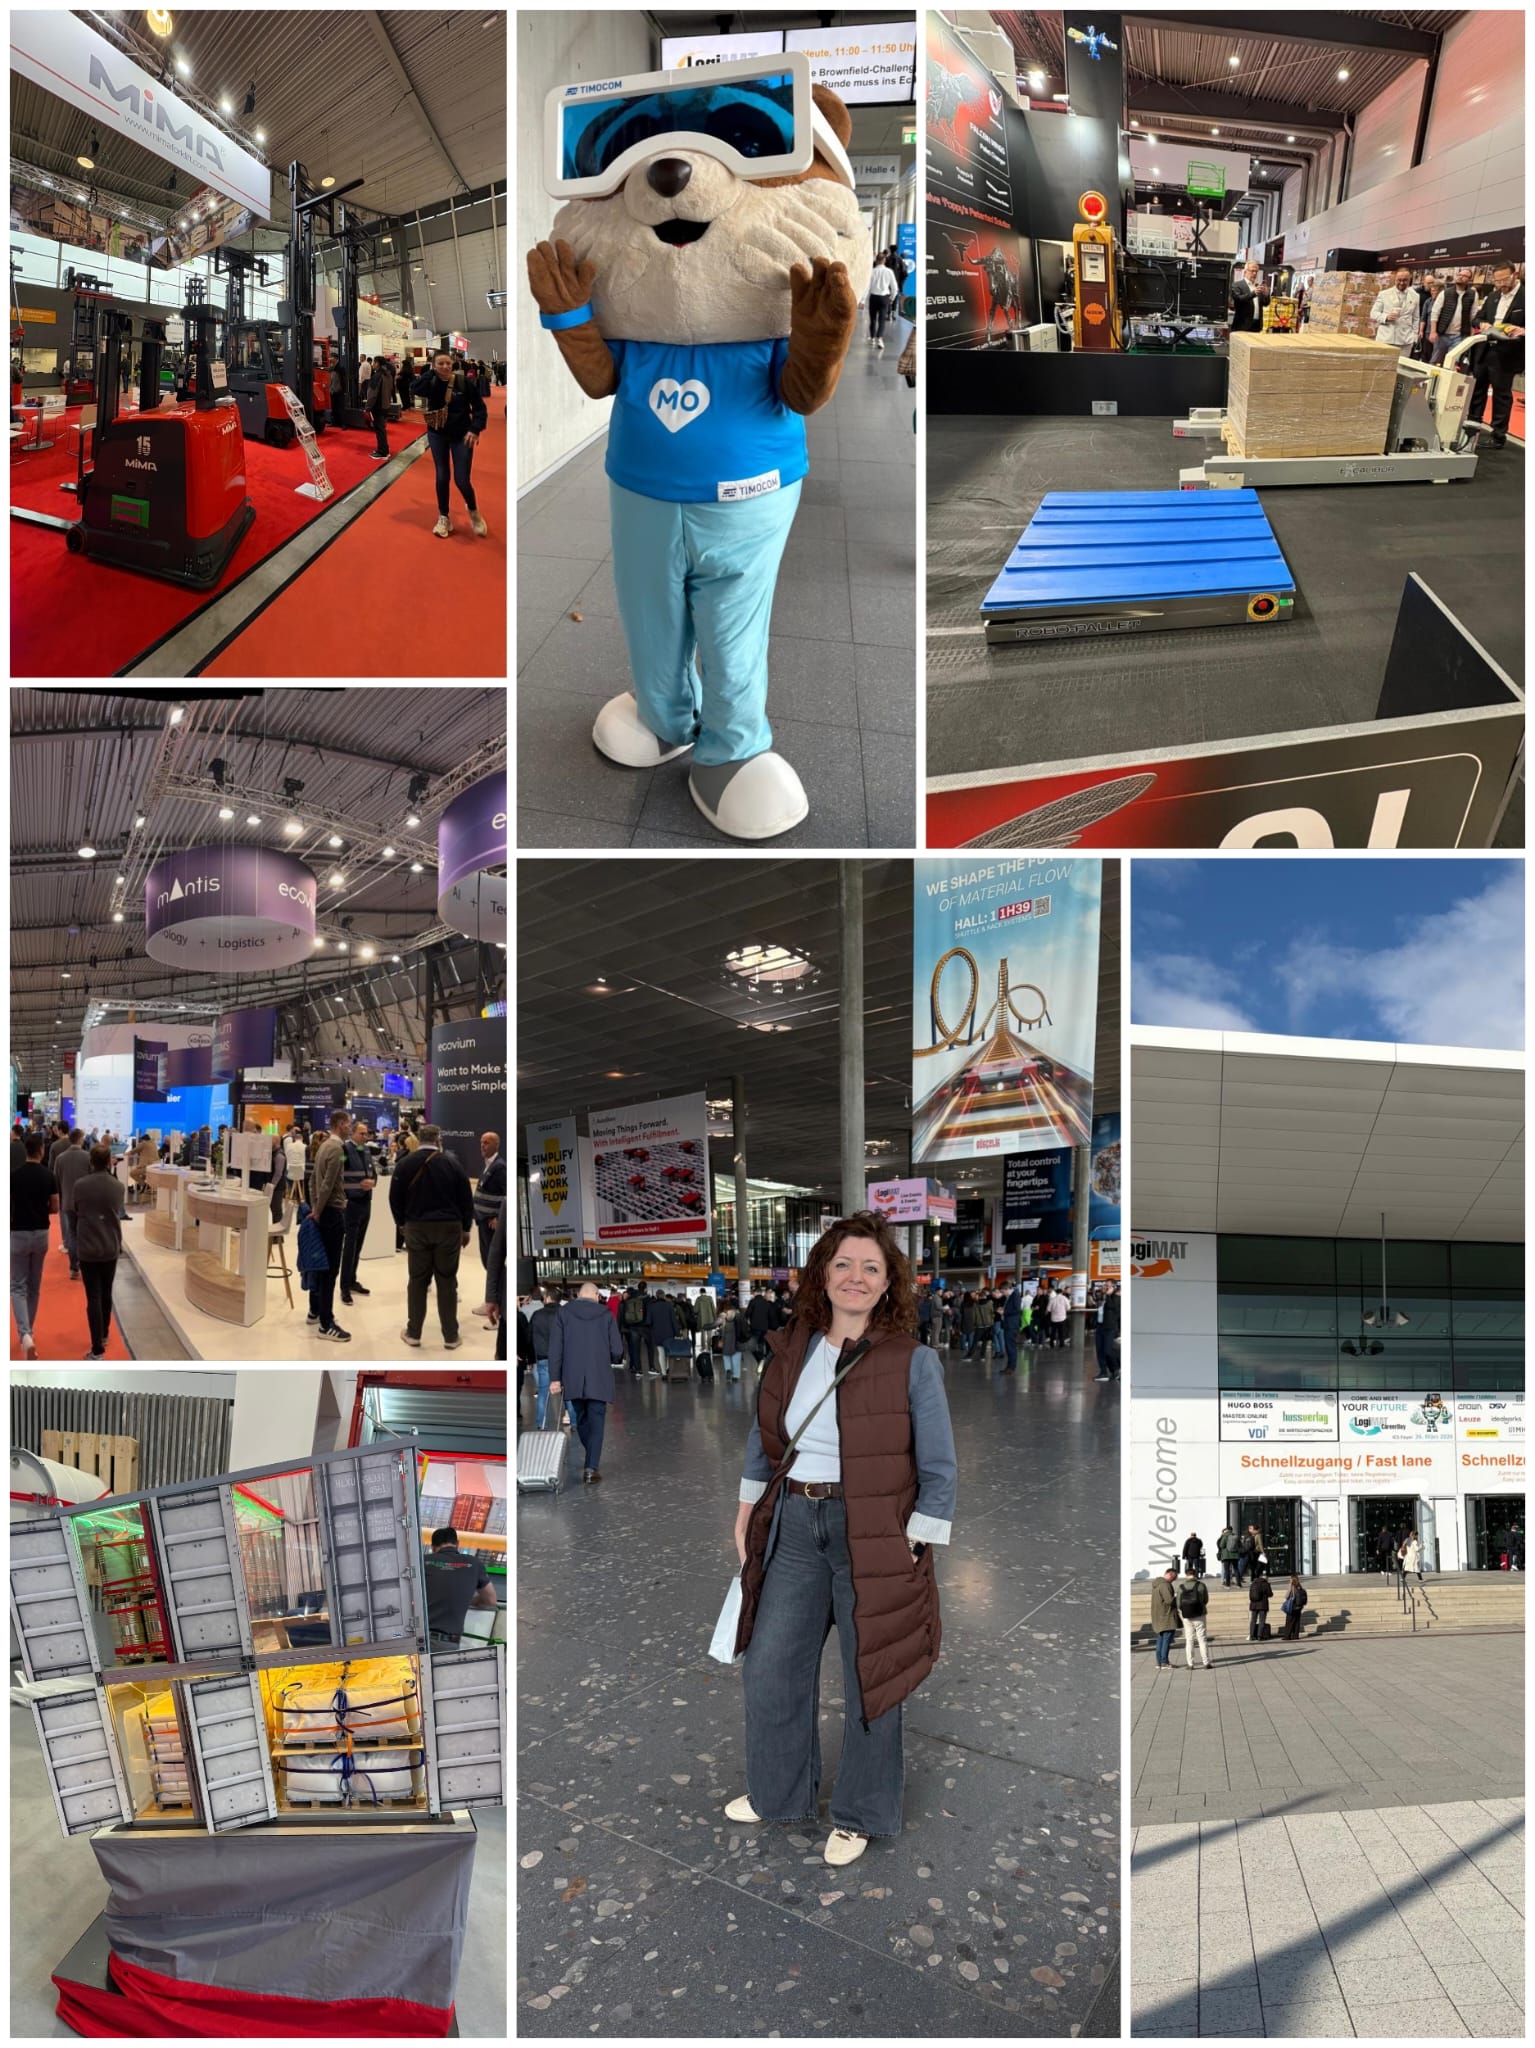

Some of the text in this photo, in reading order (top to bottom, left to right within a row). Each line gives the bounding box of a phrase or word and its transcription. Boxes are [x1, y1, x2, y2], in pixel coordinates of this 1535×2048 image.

[834, 46, 860, 56] 11:00
[872, 44, 896, 54] 11:50
[580, 80, 622, 94] TIMOCOM
[853, 78, 879, 87] muss
[882, 77, 896, 85] ins
[865, 165, 888, 175] Halle
[889, 164, 896, 174] 4
[948, 294, 966, 303] BULL
[656, 389, 700, 413] MO
[739, 478, 778, 496] TIMOCOM
[1015, 619, 1141, 639] ROBO-PALLET
[926, 858, 1025, 897] WE SHAPE THE
[939, 864, 1073, 913] OF MATERIAL FLOW
[954, 913, 988, 931] HALL:
[1000, 901, 1031, 919] 1H39
[218, 936, 265, 951] Logistics
[437, 1037, 476, 1053] ecovium
[437, 1063, 502, 1078] Want to Make
[437, 1082, 470, 1093] Discover
[592, 1127, 616, 1138] Moving
[616, 1123, 638, 1134] Things
[609, 1134, 641, 1145] Intelligent
[531, 1148, 574, 1165] SIMPLIFY
[1007, 1156, 1061, 1169] Total control
[541, 1164, 567, 1177] YOUR
[1007, 1169, 1036, 1180] at your
[541, 1176, 568, 1190] WORK
[1006, 1176, 1049, 1188] fingertips
[542, 1191, 568, 1203] FLOW
[1342, 1403, 1408, 1412] YOUR FUTURE
[1282, 1411, 1328, 1424] hussverlag
[1248, 1428, 1266, 1439] VDI
[1240, 1454, 1432, 1470] Schnellzugang / Fast lane
[1148, 1416, 1177, 1566] Welcome
